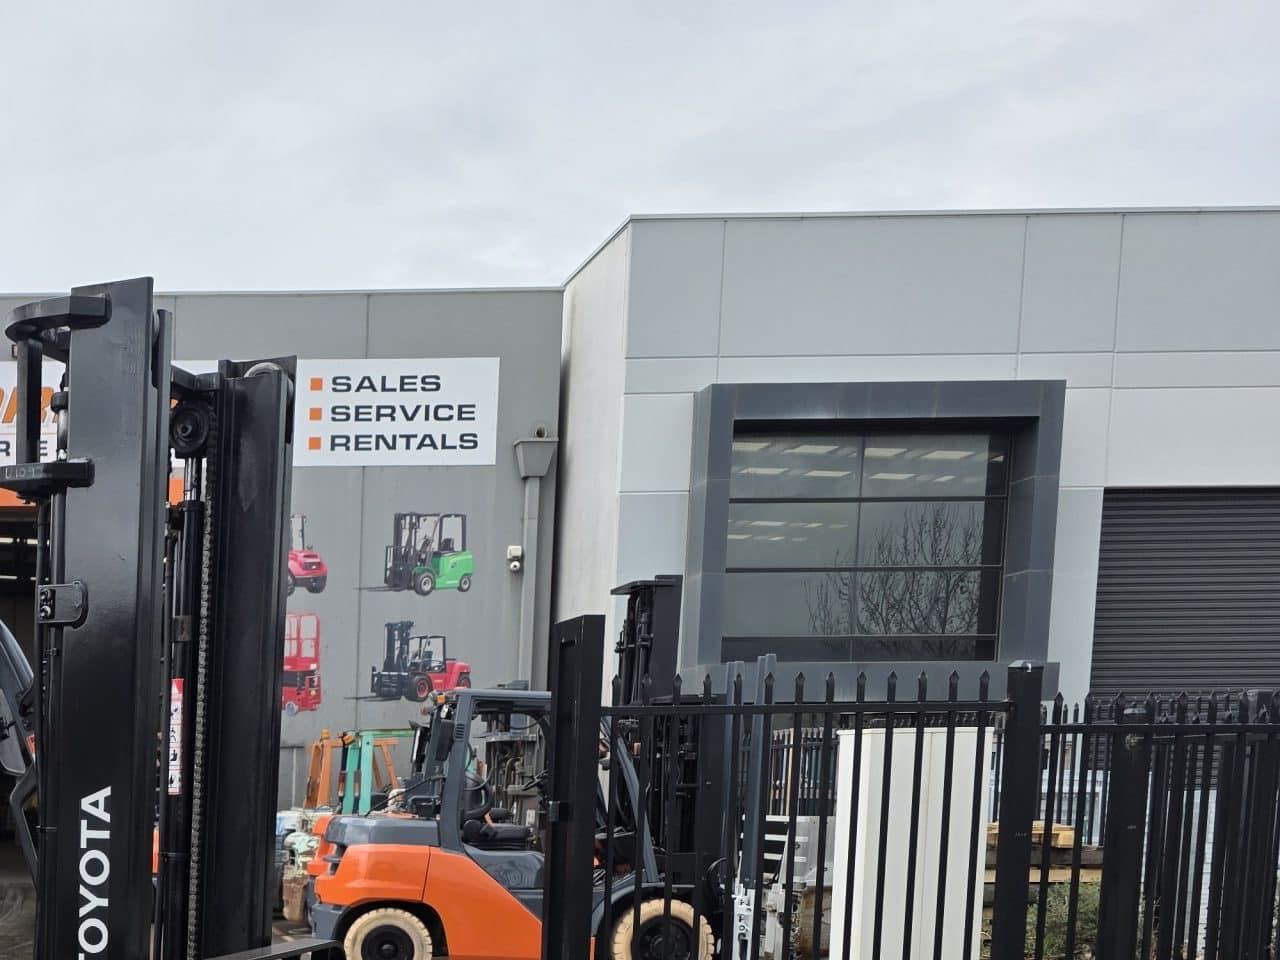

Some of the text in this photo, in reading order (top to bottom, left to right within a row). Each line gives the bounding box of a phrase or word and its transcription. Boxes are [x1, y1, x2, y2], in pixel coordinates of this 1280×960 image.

[330, 374, 442, 393] SALES
[330, 403, 477, 422] SERVICE
[329, 432, 479, 451] RENTALS
